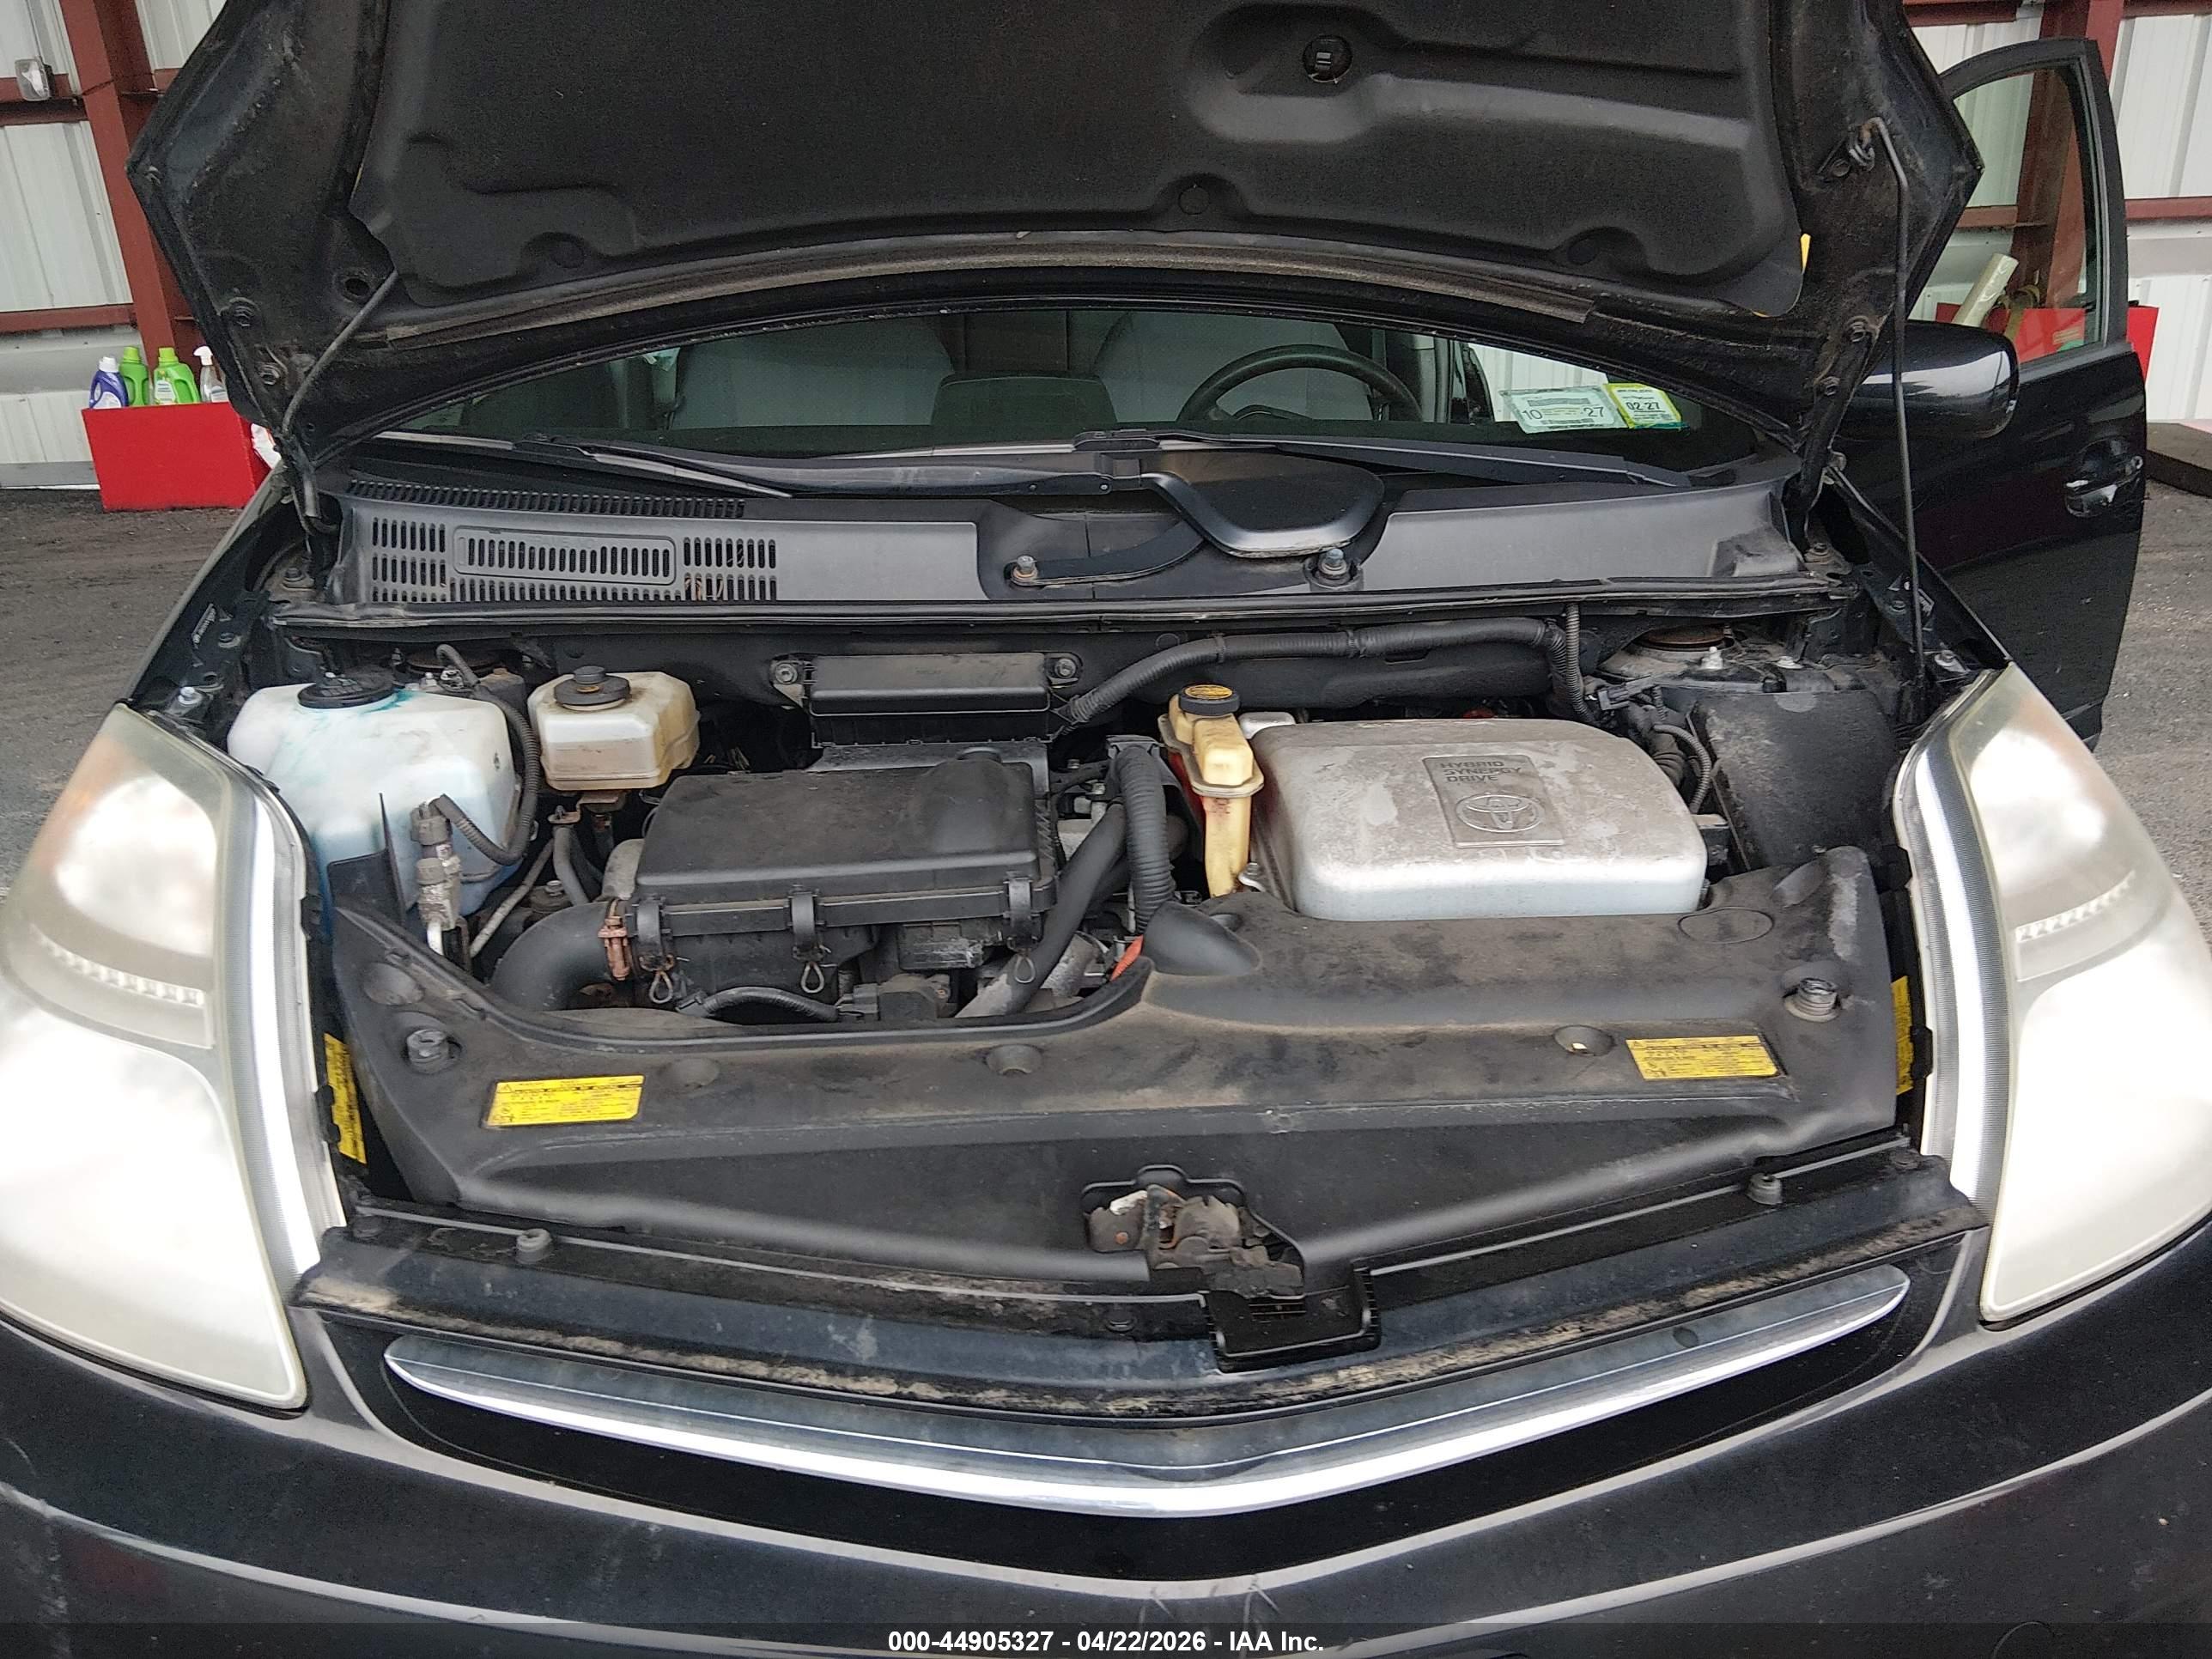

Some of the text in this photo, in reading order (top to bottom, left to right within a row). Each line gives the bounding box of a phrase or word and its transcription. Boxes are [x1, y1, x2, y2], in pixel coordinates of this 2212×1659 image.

[1626, 401, 1661, 410] 02 27
[1522, 409, 1543, 421] 10
[1583, 406, 1605, 418] 27
[1443, 767, 1522, 775] SYNERGY
